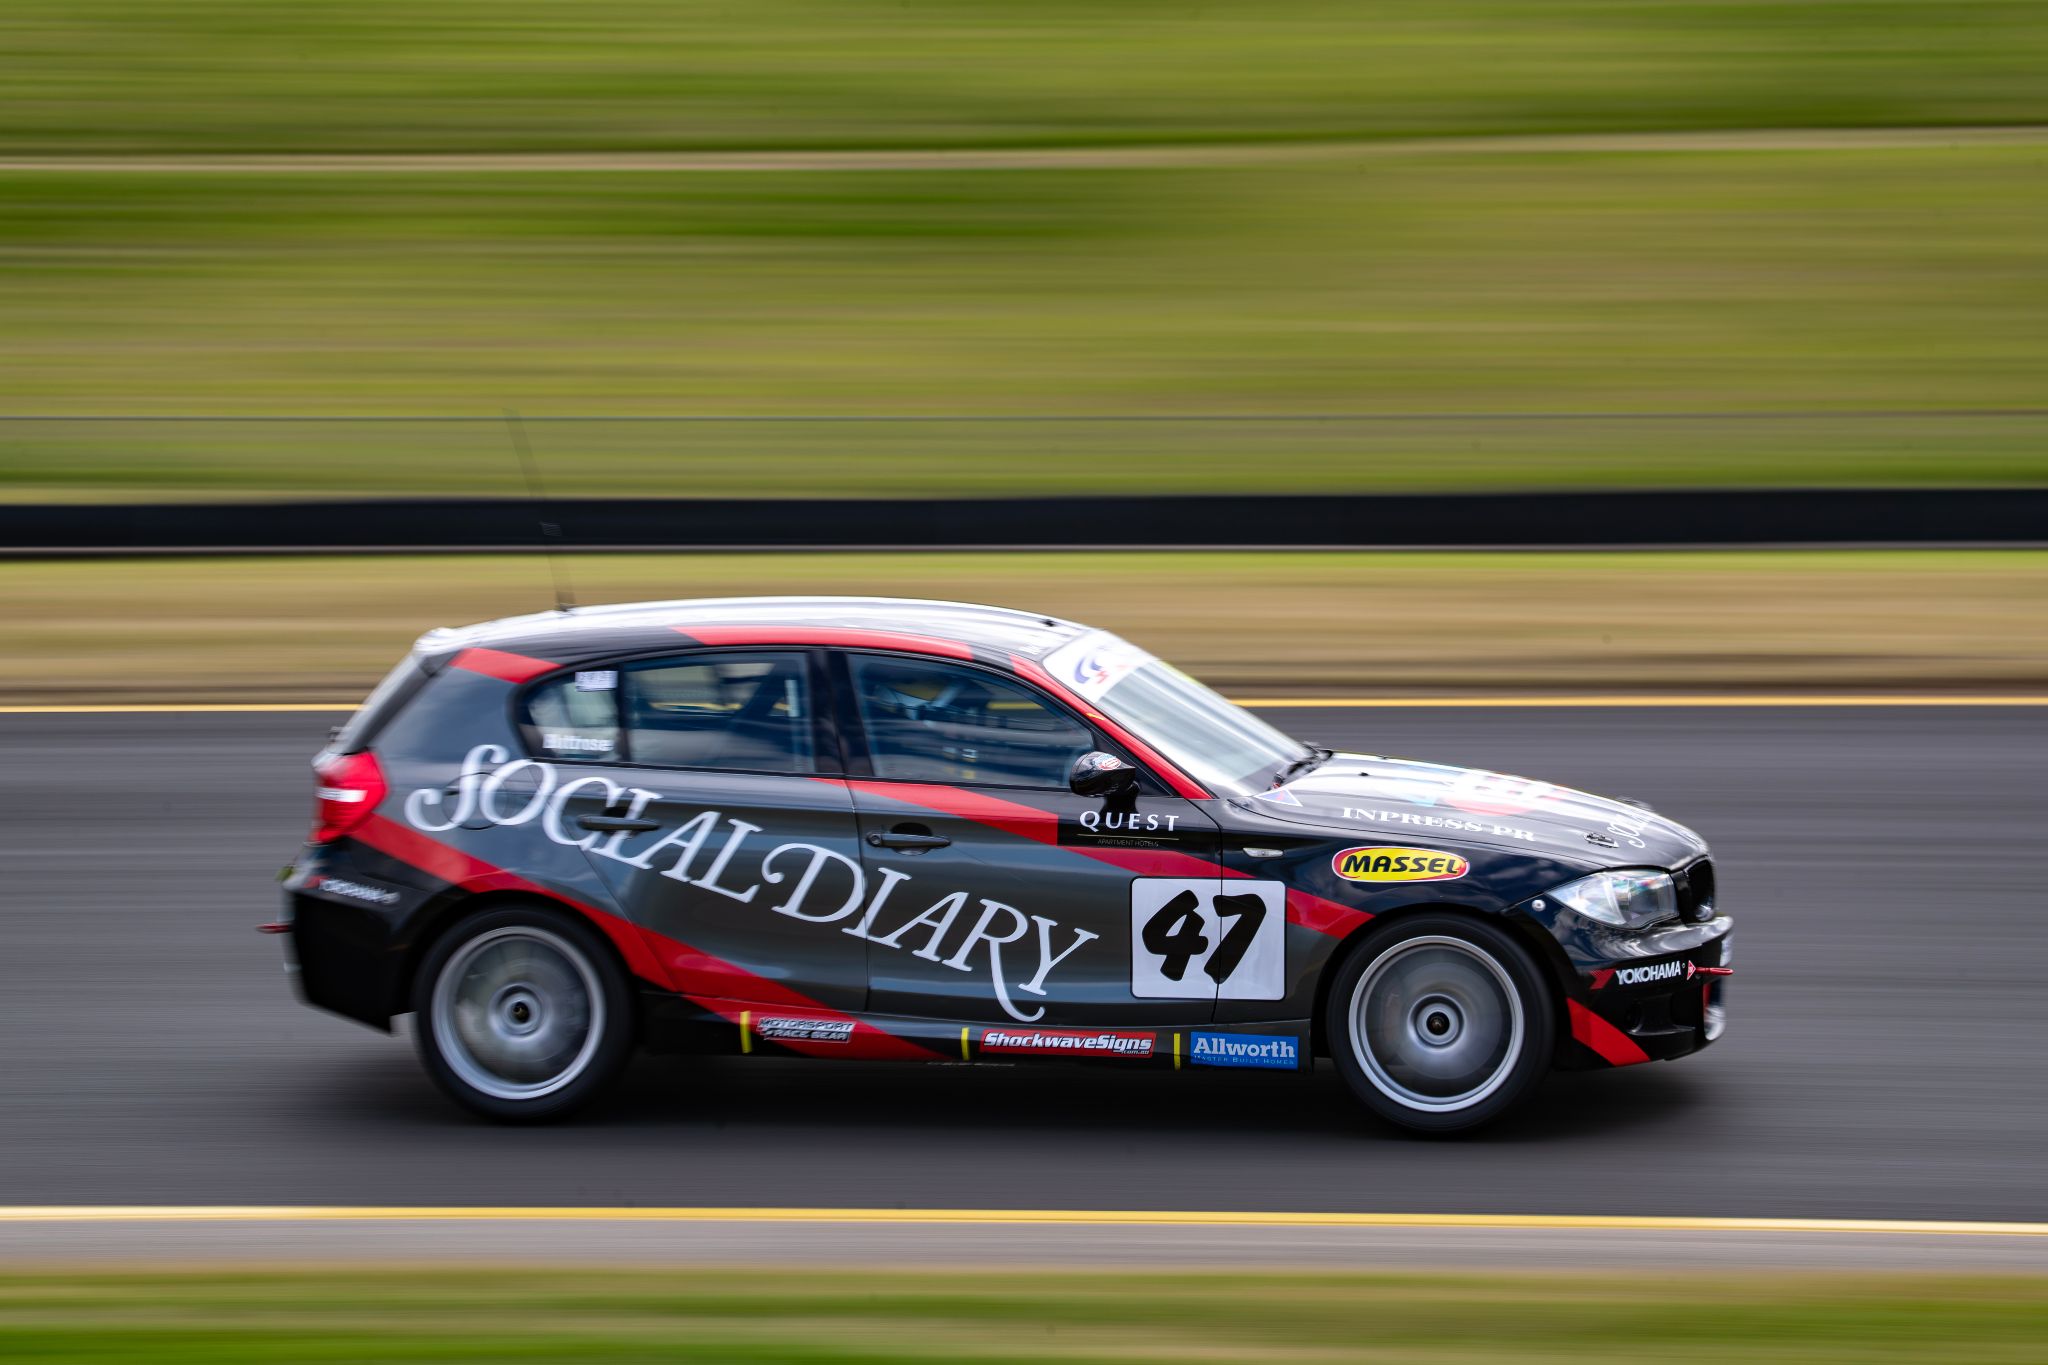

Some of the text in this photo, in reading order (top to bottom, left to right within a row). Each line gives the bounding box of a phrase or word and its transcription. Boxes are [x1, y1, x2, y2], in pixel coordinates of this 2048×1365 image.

[1080, 811, 1180, 832] QUEST
[1341, 807, 1536, 842] INPRESS PR
[1342, 854, 1460, 875] MASSEL
[404, 744, 1099, 1023] SOCIAL DIARY
[1142, 889, 1267, 985] 47
[1616, 960, 1682, 985] YOKOHAMA
[760, 1019, 853, 1031] MOTORSPORT
[773, 1029, 848, 1040] RACE GEAR
[984, 1032, 1153, 1053] ShockwaveSigns
[1193, 1037, 1296, 1058] Allworth
